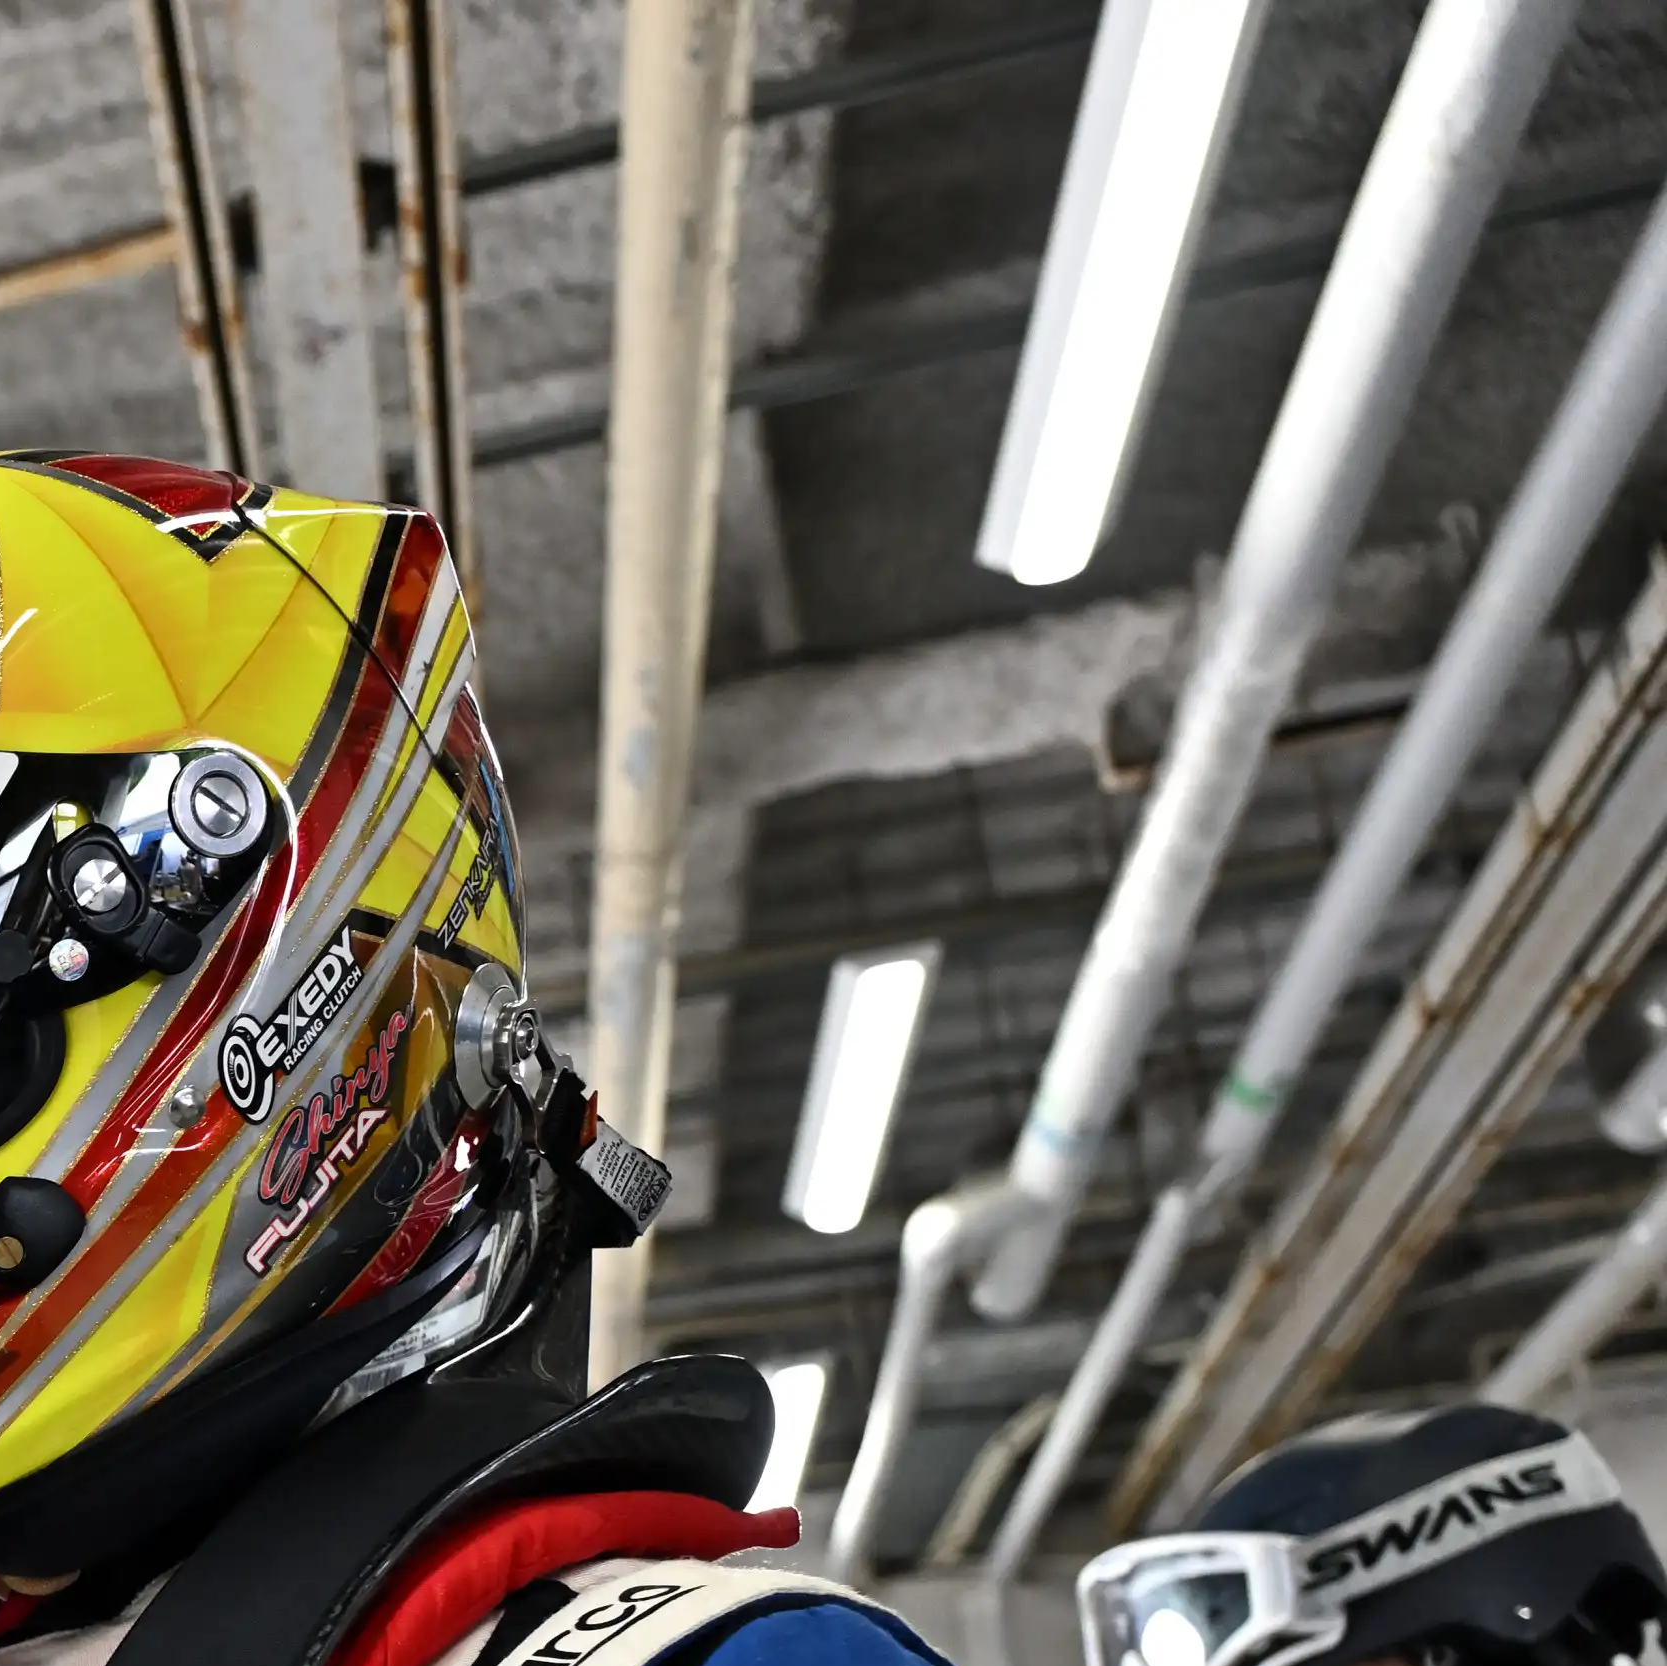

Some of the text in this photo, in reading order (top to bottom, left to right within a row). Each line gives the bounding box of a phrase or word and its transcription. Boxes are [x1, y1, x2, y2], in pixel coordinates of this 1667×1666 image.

[256, 926, 356, 1069] EXEDY
[283, 968, 363, 1071] RACING CLUTCH
[260, 1010, 410, 1206] Shinya
[247, 1108, 389, 1274] FUJITA
[1302, 1460, 1565, 1593] SWANS
